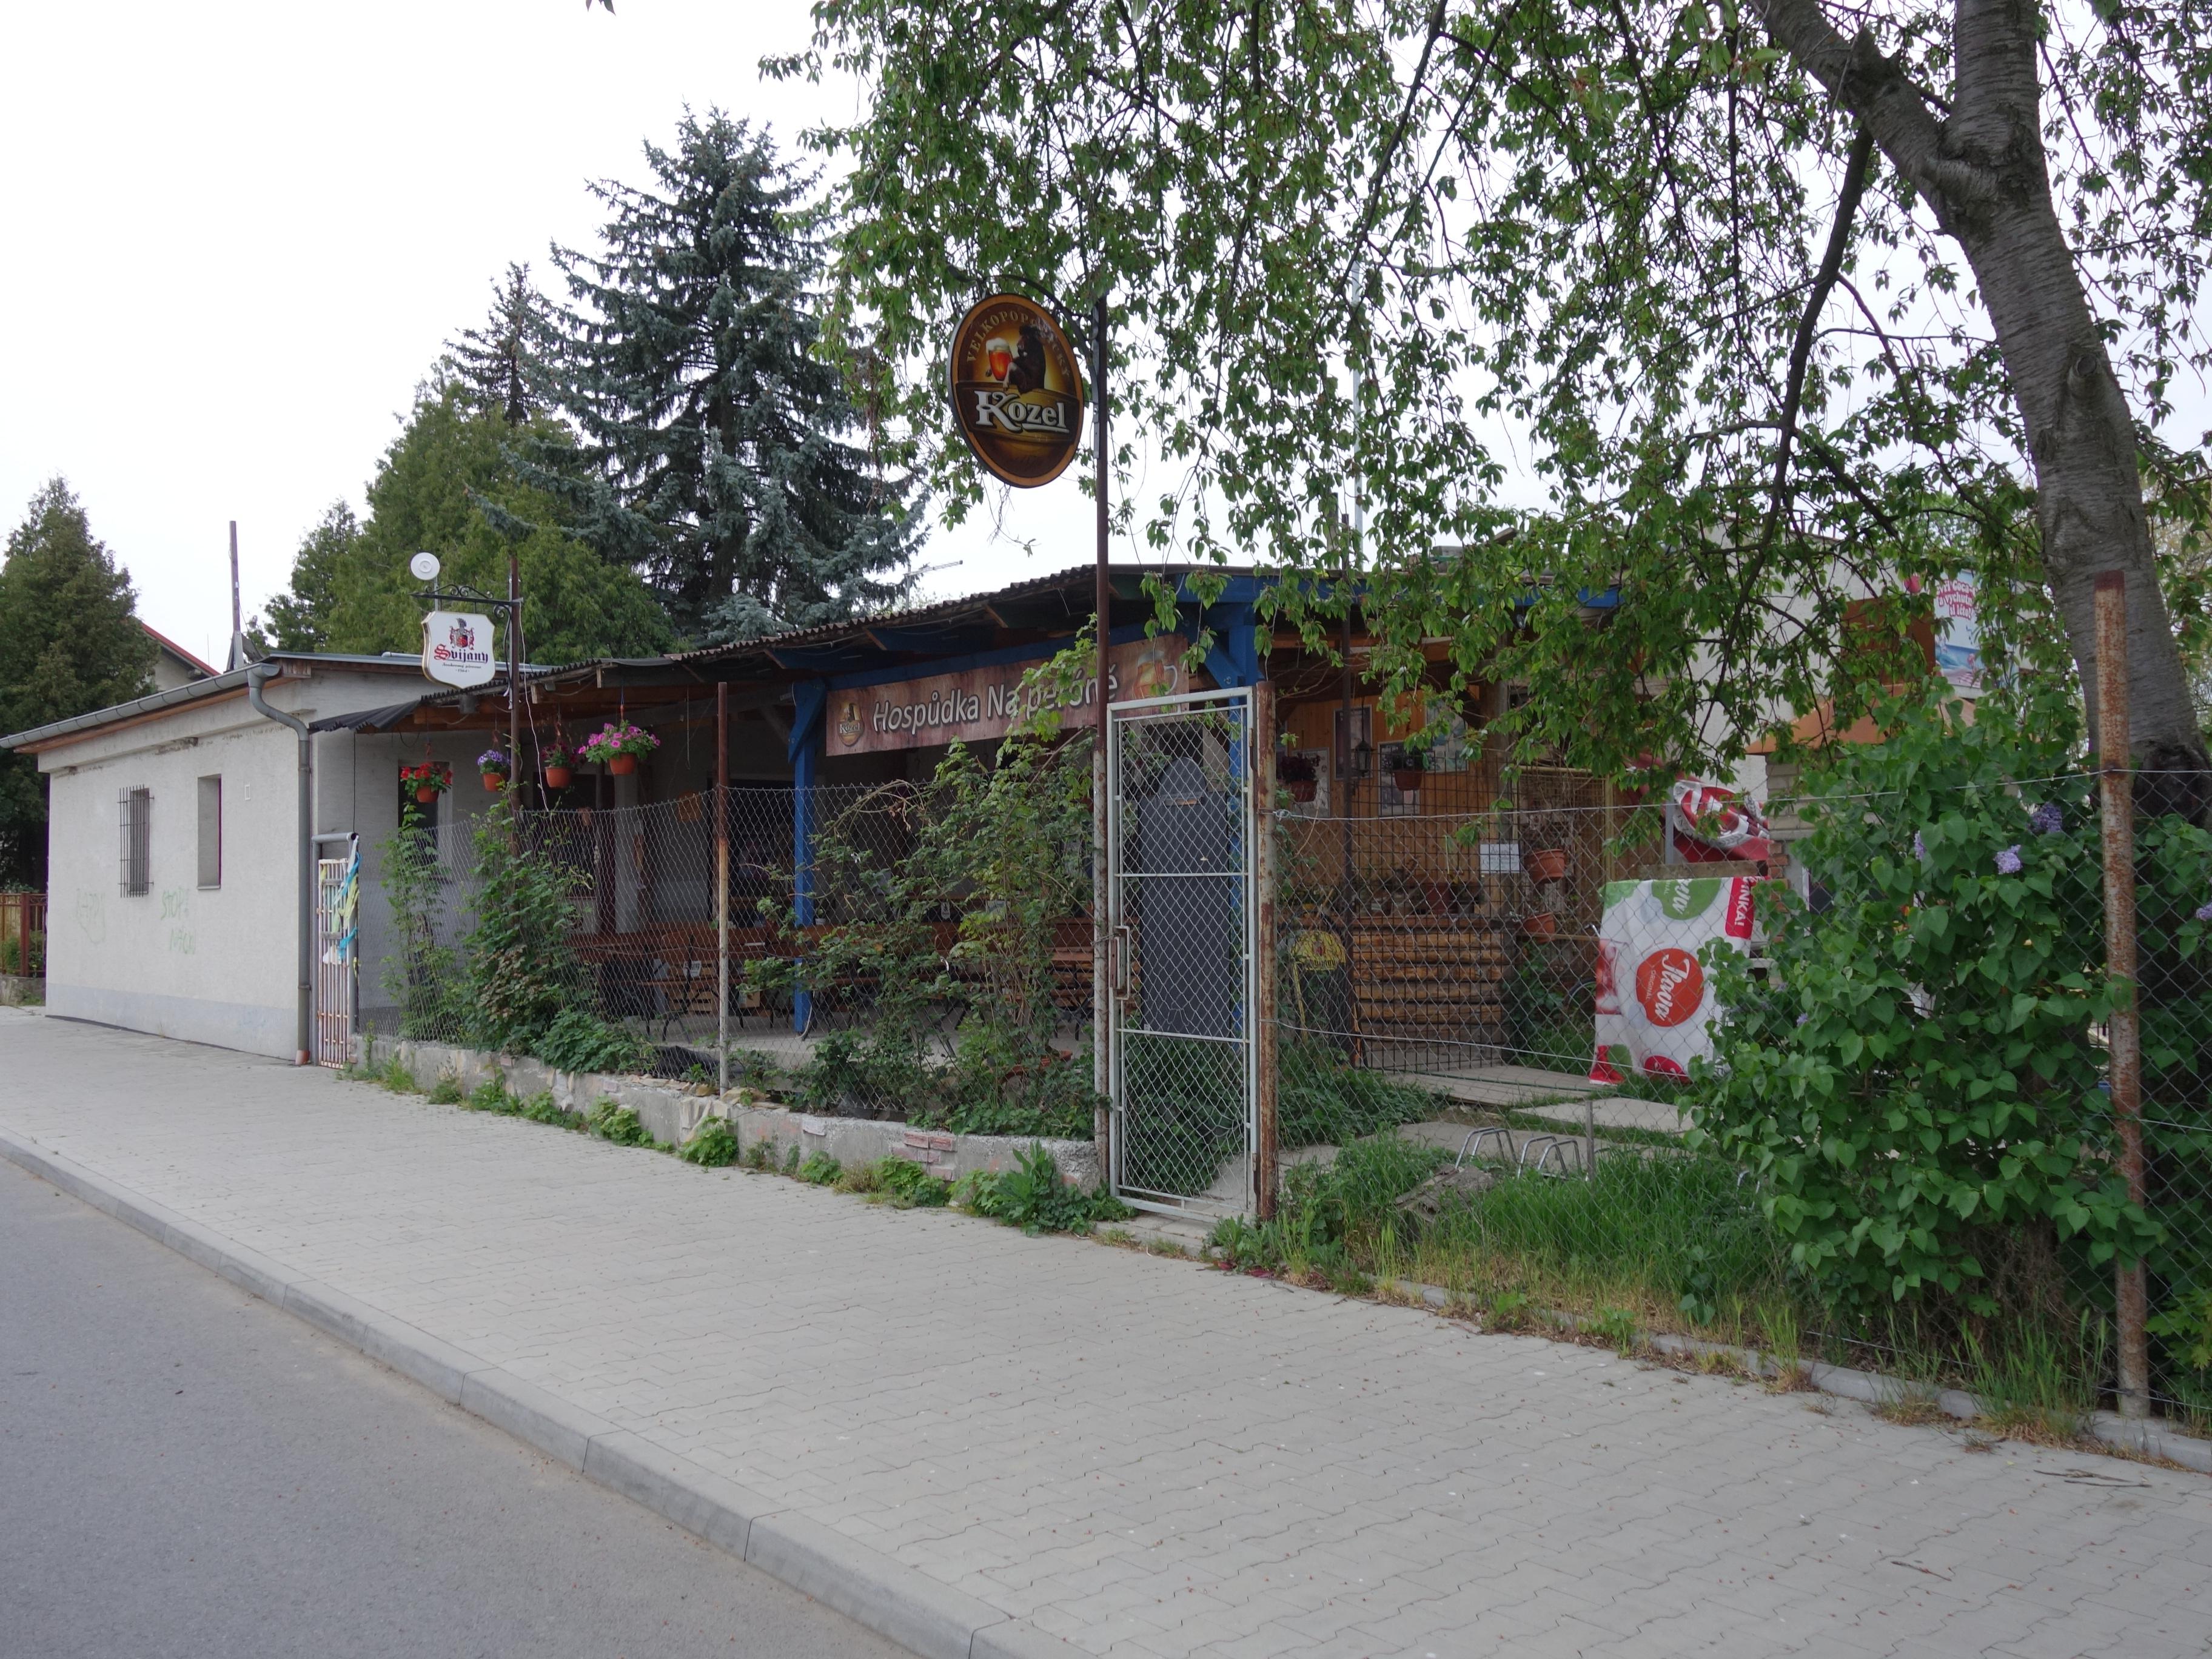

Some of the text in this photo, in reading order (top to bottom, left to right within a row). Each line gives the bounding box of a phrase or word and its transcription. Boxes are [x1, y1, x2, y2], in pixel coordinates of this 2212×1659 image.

[974, 390, 1070, 434] Kozel
[434, 643, 488, 664] Svijany
[873, 688, 979, 736] Hospůdka
[987, 683, 1018, 718] Na
[1645, 970, 1657, 1000] ORIGINAL
